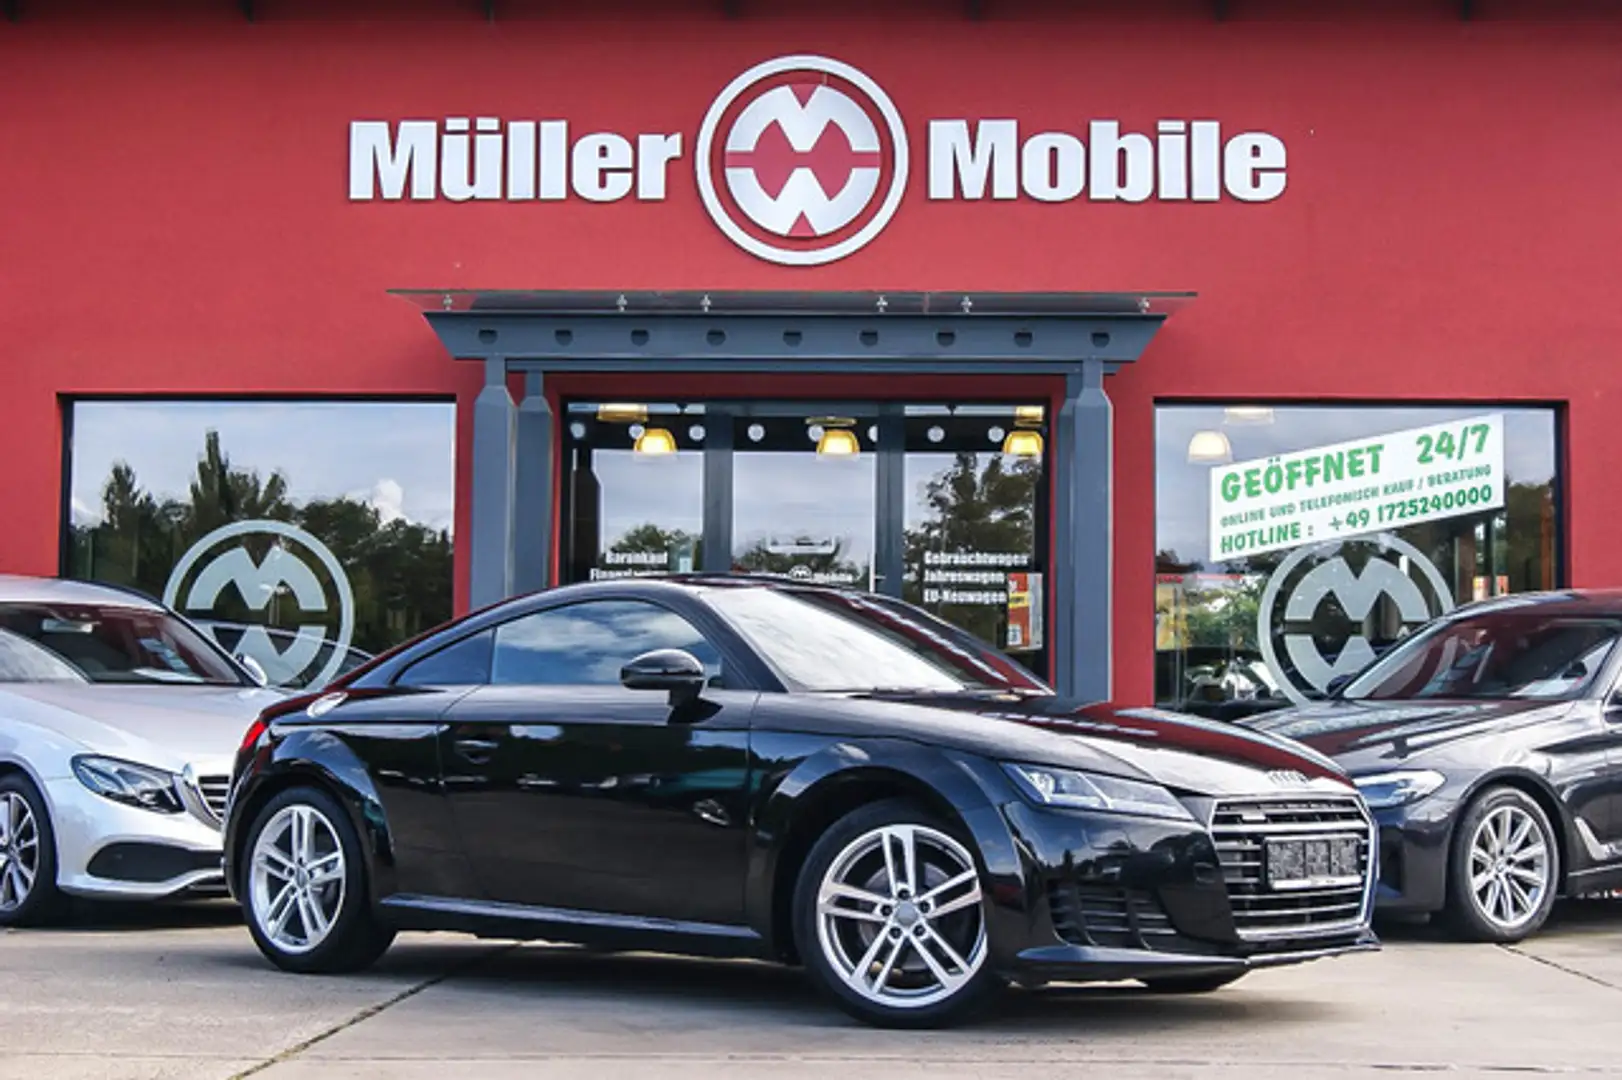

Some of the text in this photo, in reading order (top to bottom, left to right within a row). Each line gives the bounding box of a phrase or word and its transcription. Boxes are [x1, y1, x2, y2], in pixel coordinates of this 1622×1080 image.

[349, 118, 1287, 202] Müller Mobile
[1220, 508, 1266, 528] ONLINE
[1269, 502, 1297, 518] UND
[1300, 486, 1380, 513] TELEFONISCH
[1383, 479, 1414, 496] KAUF
[1427, 464, 1492, 488] BERATUNG
[1221, 424, 1491, 503] GEÖFFNET 24/7
[1220, 521, 1301, 554] HOTLINE
[1377, 484, 1493, 524] 1725240000
